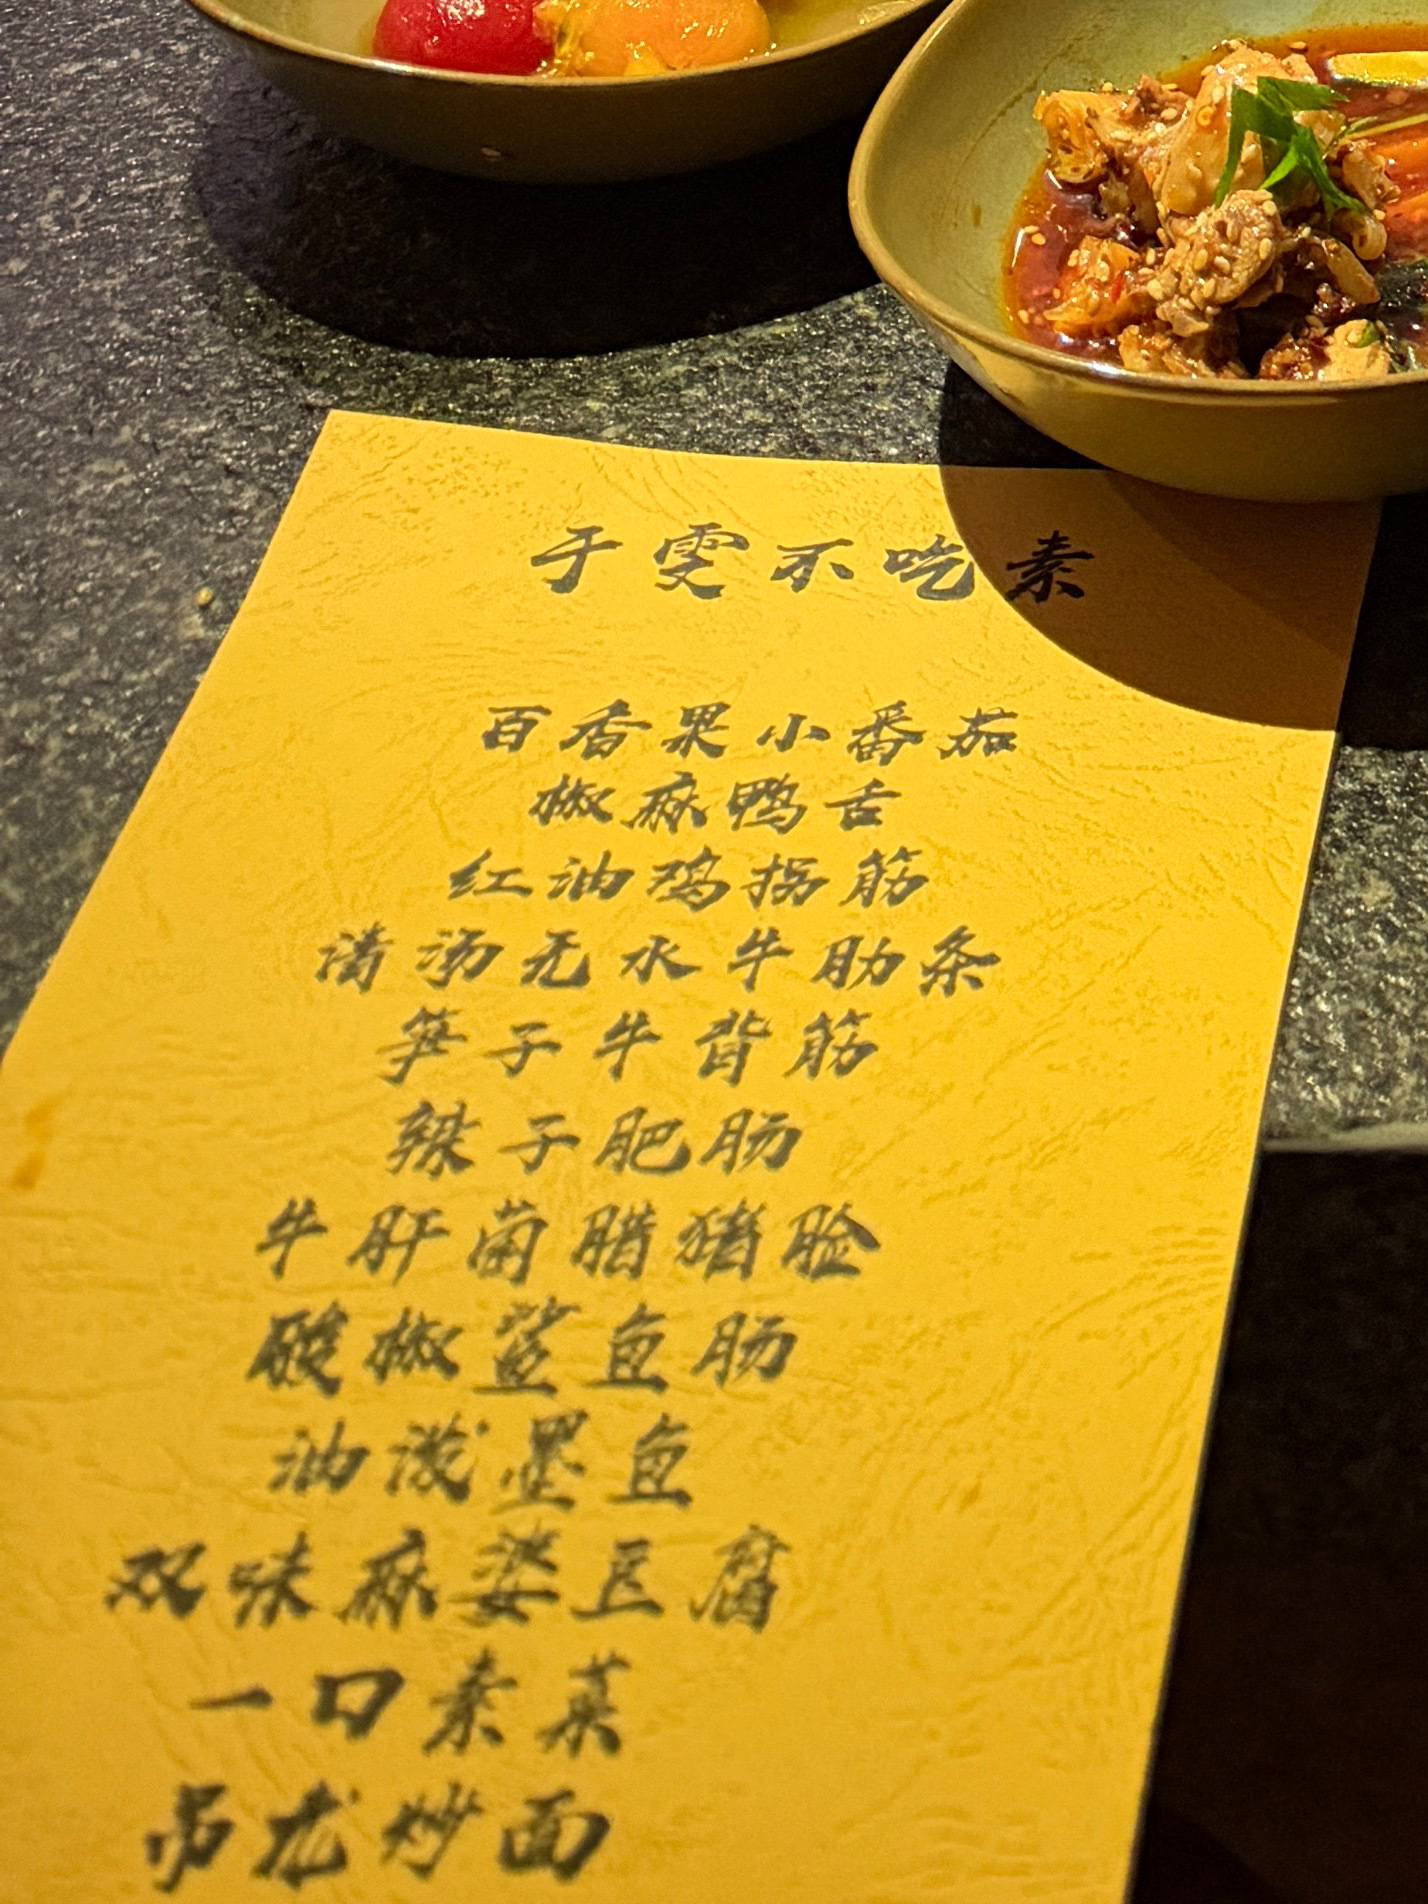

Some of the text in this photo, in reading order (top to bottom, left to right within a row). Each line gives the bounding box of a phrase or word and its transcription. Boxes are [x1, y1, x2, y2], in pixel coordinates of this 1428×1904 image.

[481, 698, 1018, 767] 百香果小番茄
[528, 771, 901, 836] 椒麻鸭舌
[315, 924, 1002, 998] 清汤无水牛肋条
[388, 1100, 803, 1180] 辣子肥肠
[269, 1409, 694, 1511] 油泼墨鱼
[104, 1527, 789, 1633] 双味麻婆豆腐
[189, 1646, 631, 1760] 一口素菜
[144, 1781, 612, 1896] 吊龙炒面
